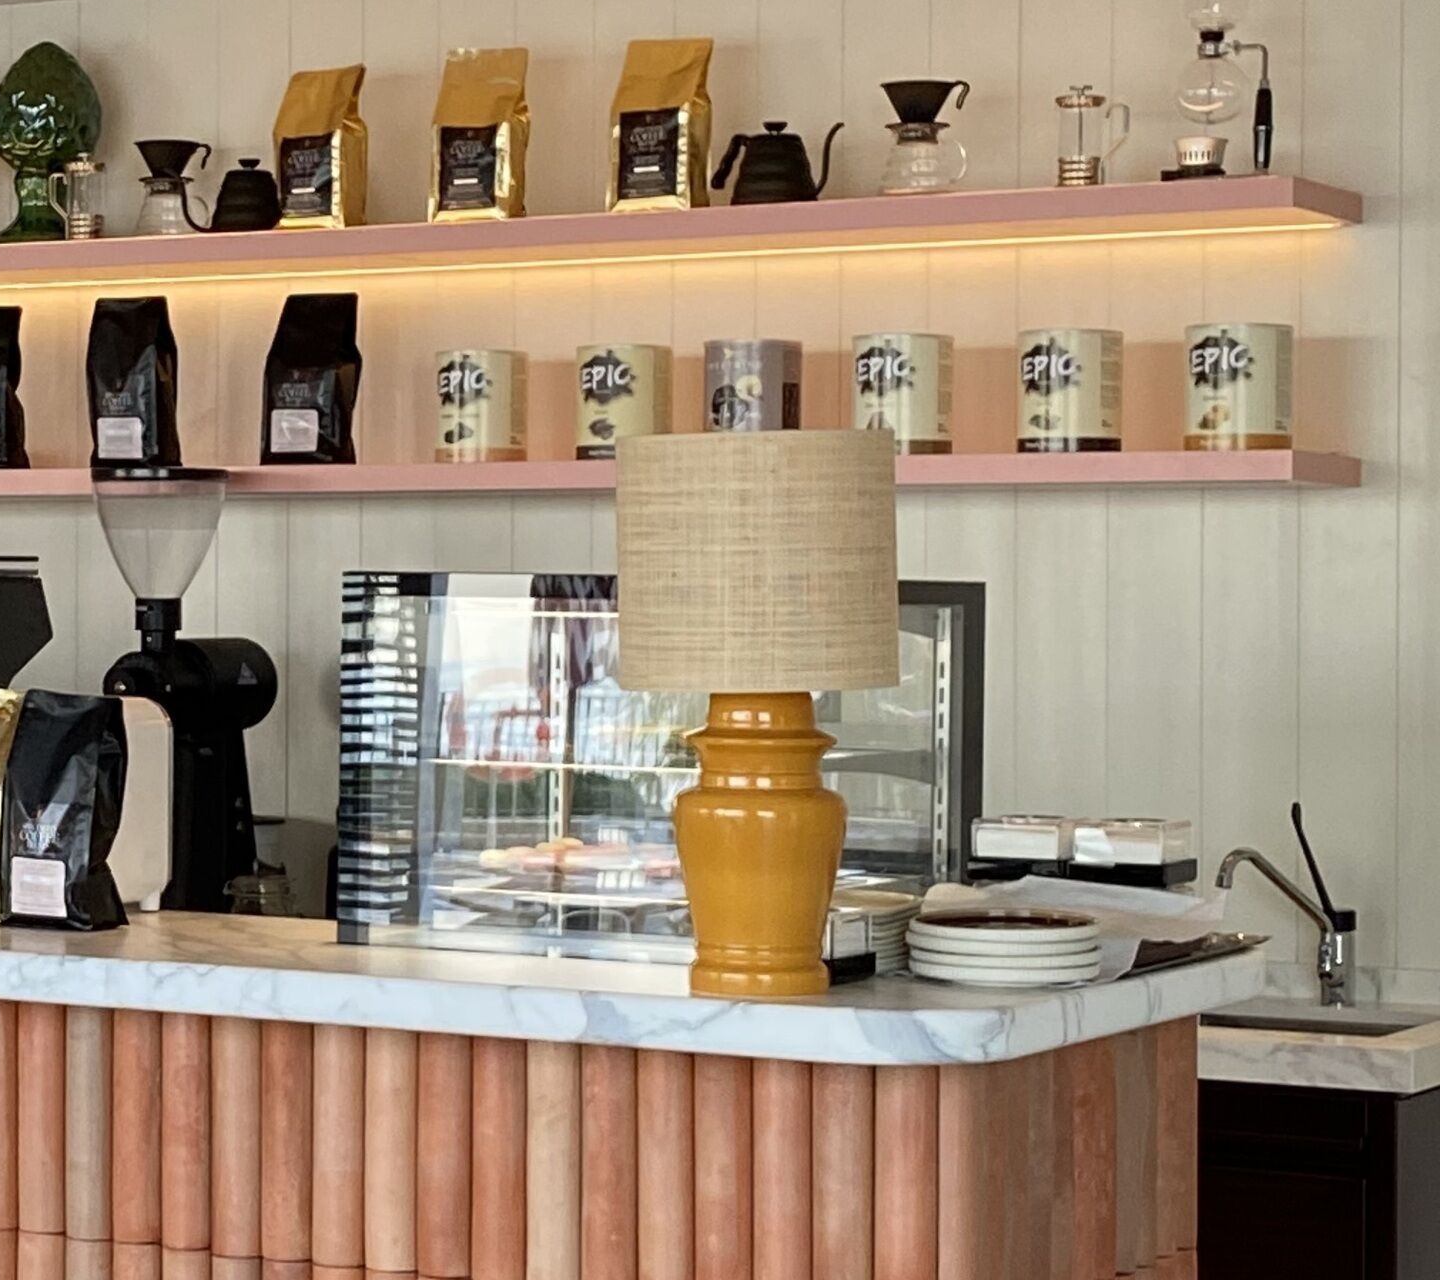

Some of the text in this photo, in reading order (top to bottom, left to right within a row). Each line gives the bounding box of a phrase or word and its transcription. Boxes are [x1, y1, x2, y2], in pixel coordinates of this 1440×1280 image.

[857, 353, 910, 382] EPIC
[1022, 353, 1078, 381] EPIC
[1191, 344, 1250, 374] EPIC
[438, 367, 488, 394] EPIC
[581, 362, 632, 391] EPIC
